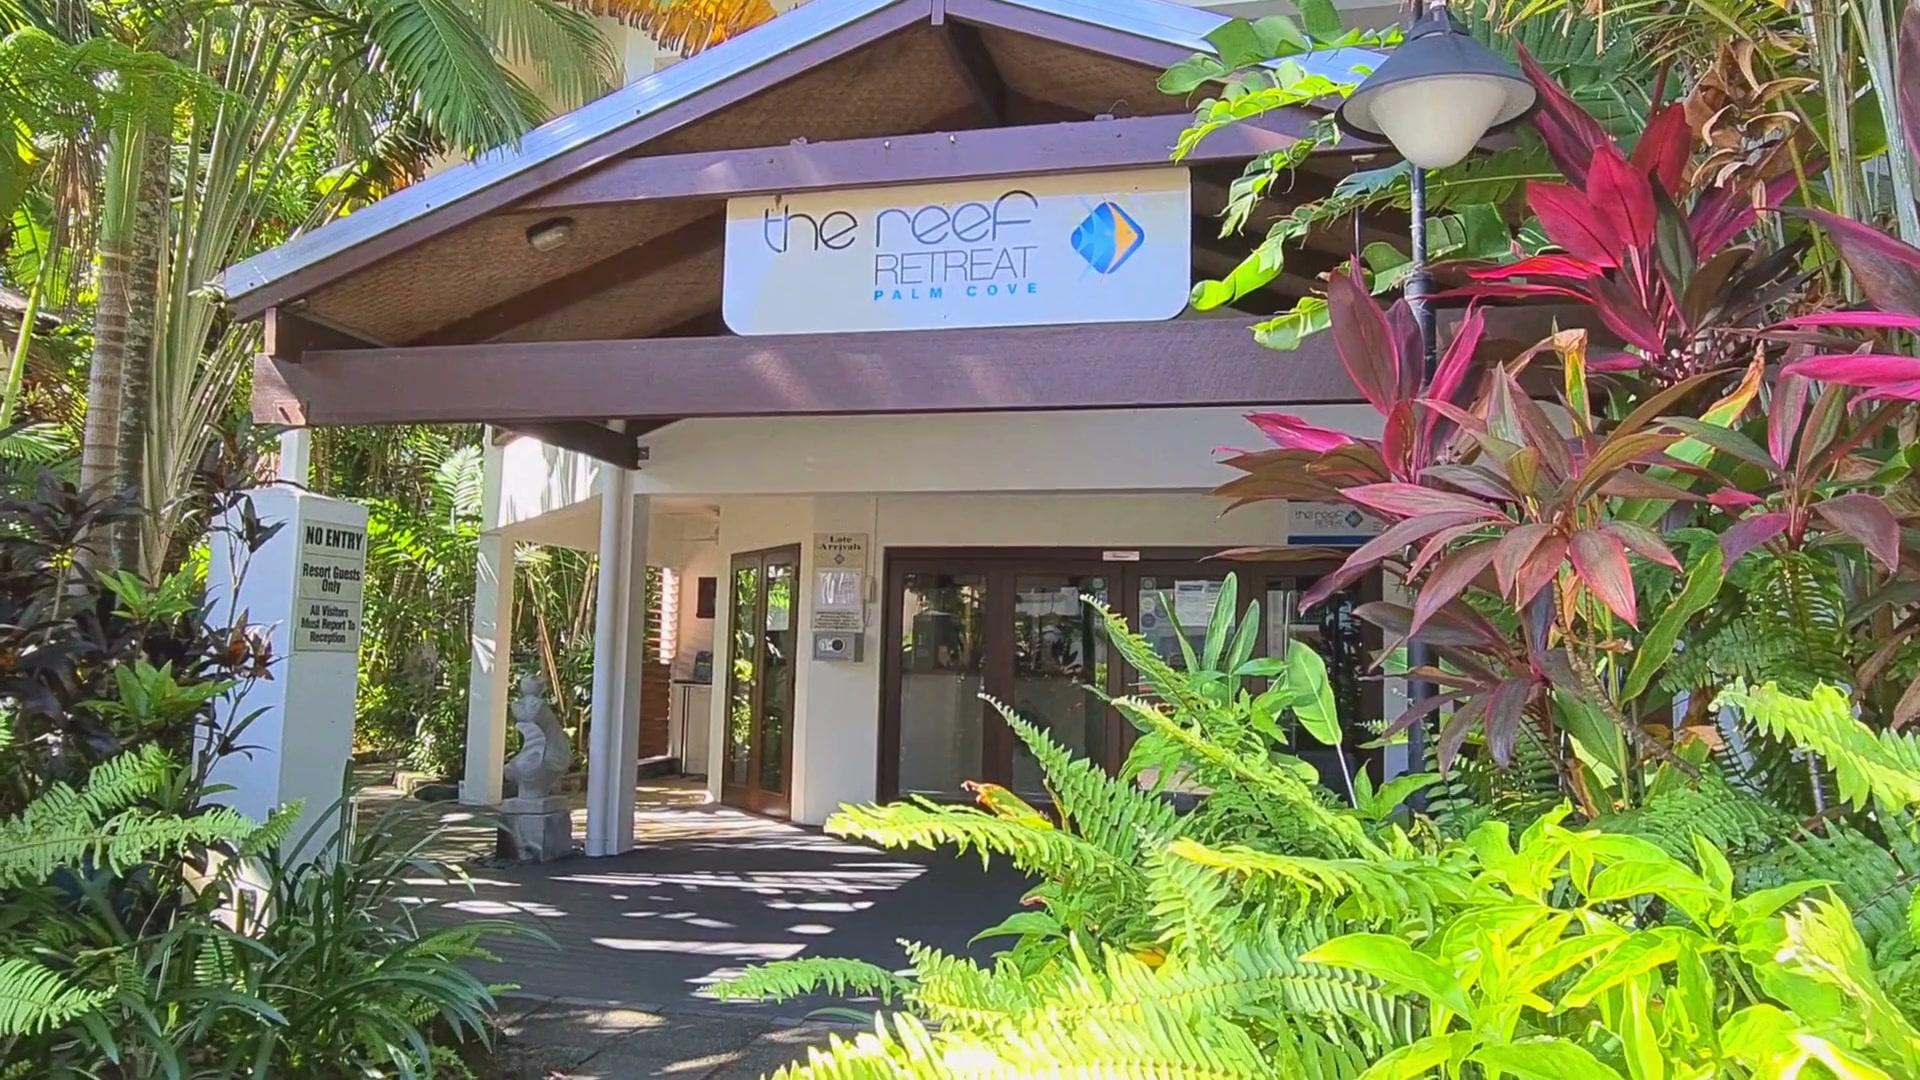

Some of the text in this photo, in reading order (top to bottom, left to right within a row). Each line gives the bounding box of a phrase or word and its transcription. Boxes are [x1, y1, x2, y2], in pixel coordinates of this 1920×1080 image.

[763, 190, 1039, 253] the reef
[874, 246, 1038, 286] RETREAT
[873, 282, 1038, 301] PALM COVE
[305, 526, 364, 551] NO ENTRY
[829, 535, 852, 544] Late
[819, 543, 862, 551] Arrivals
[302, 563, 361, 582] Resort Guests
[321, 579, 341, 594] Only
[309, 605, 349, 618] All Visitors
[301, 617, 355, 632] Must Report To
[309, 631, 346, 644] Reception
